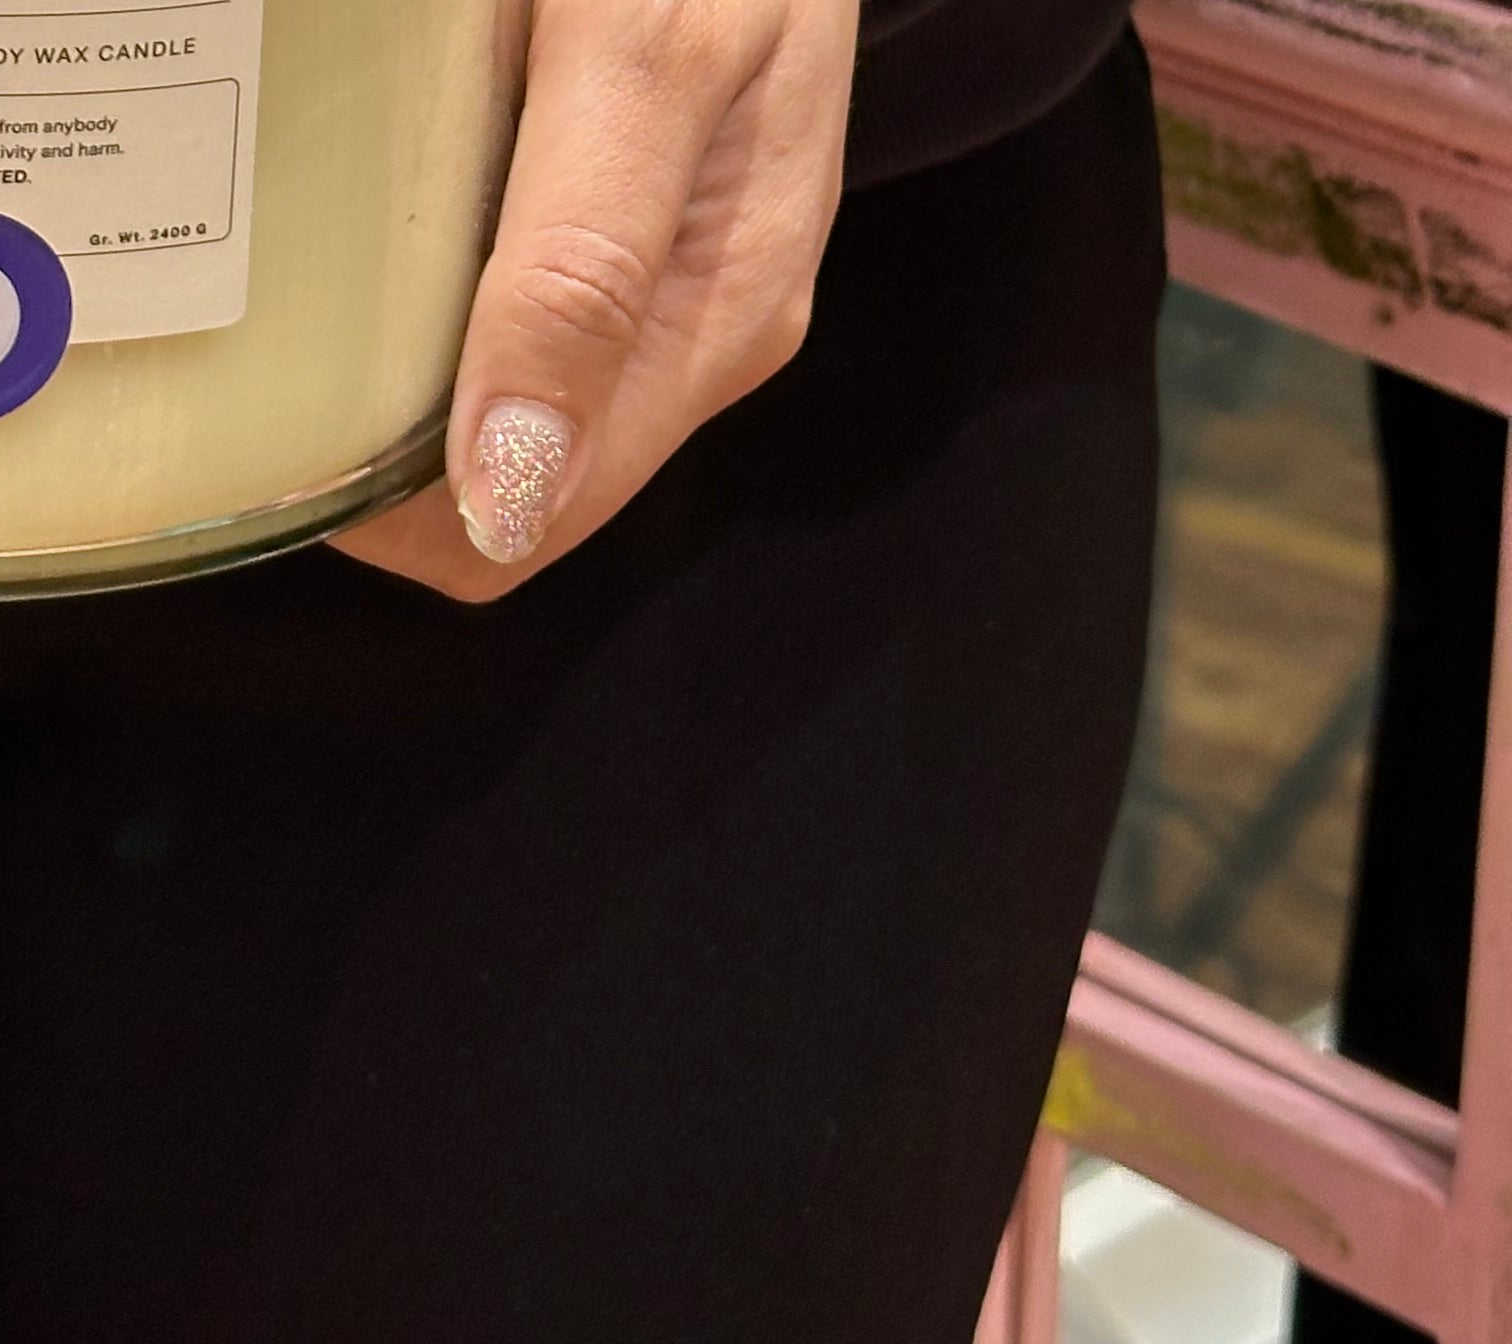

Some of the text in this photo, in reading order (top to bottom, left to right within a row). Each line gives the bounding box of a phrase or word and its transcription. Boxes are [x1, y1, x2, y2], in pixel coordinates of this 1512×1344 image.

[33, 45, 91, 66] WAX
[97, 36, 197, 63] CANDLE
[41, 114, 119, 137] anybody
[40, 141, 75, 159] and
[148, 224, 193, 246] 2400
